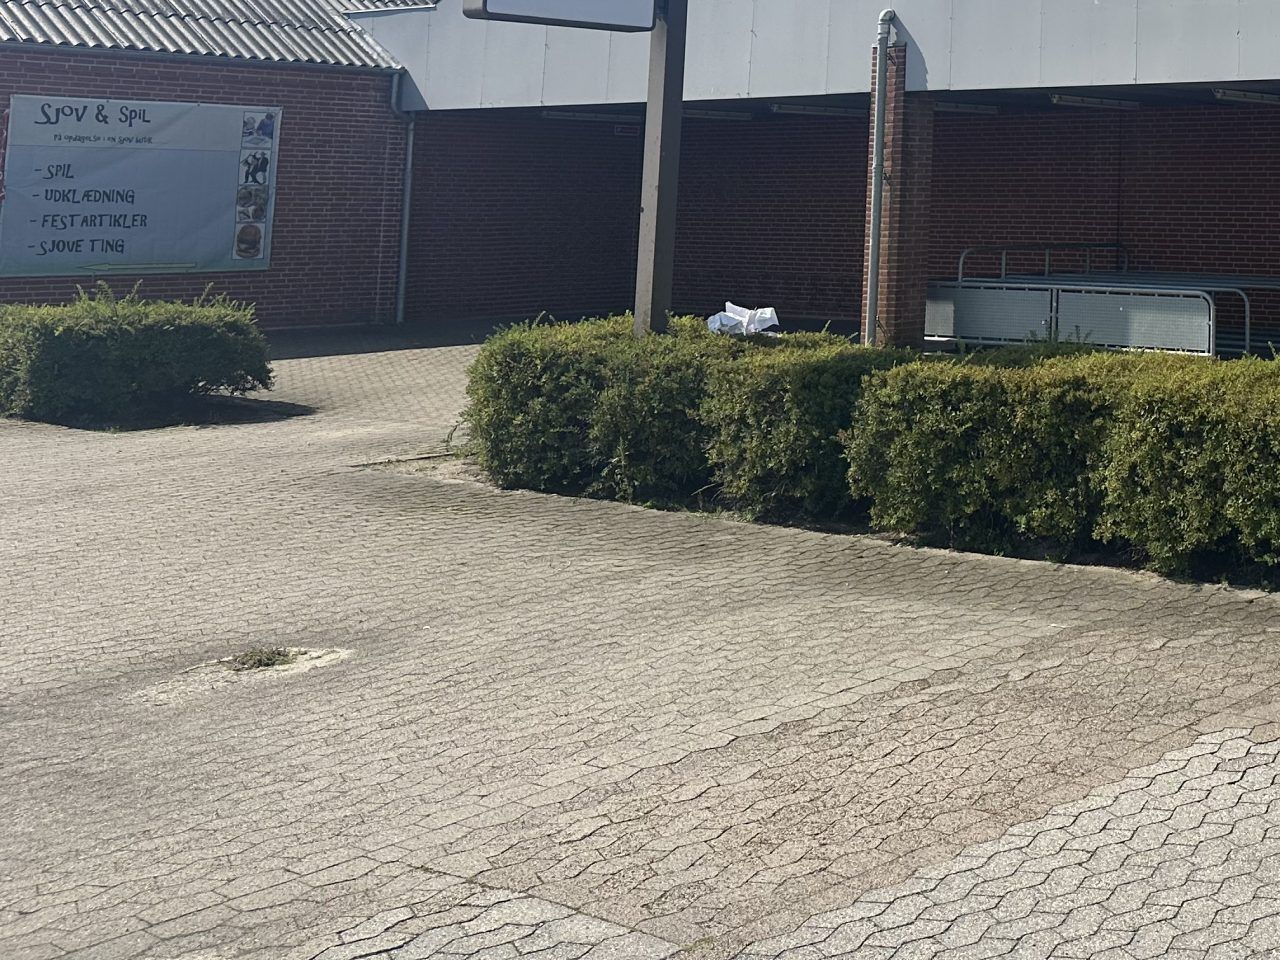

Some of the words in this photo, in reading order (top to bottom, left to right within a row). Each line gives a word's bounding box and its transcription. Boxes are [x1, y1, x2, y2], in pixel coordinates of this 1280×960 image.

[95, 102, 109, 124] &
[42, 163, 74, 180] SPIL
[44, 188, 136, 204] UDKLÆDNING
[41, 213, 148, 230] FESTARTIKLER
[35, 239, 84, 256] SJOVE
[89, 238, 125, 255] TING
